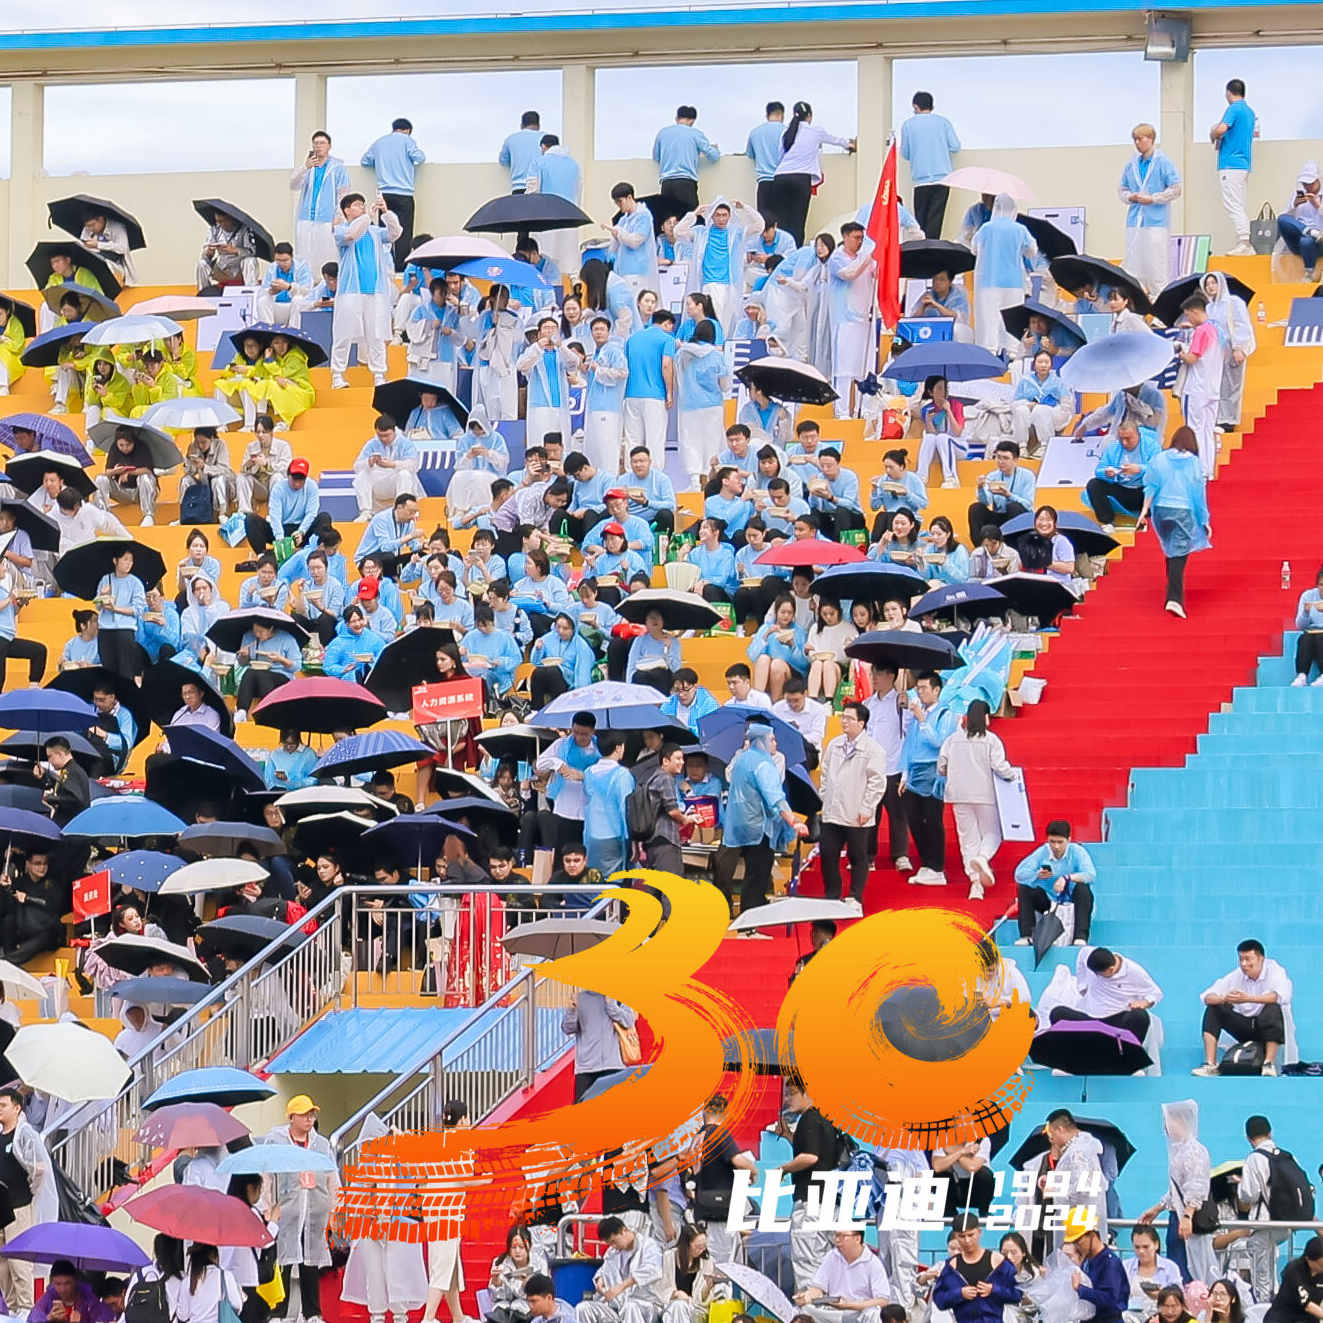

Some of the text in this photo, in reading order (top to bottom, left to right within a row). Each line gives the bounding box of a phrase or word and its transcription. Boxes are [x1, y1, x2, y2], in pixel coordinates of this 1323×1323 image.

[420, 693, 474, 708] 人力资源系统
